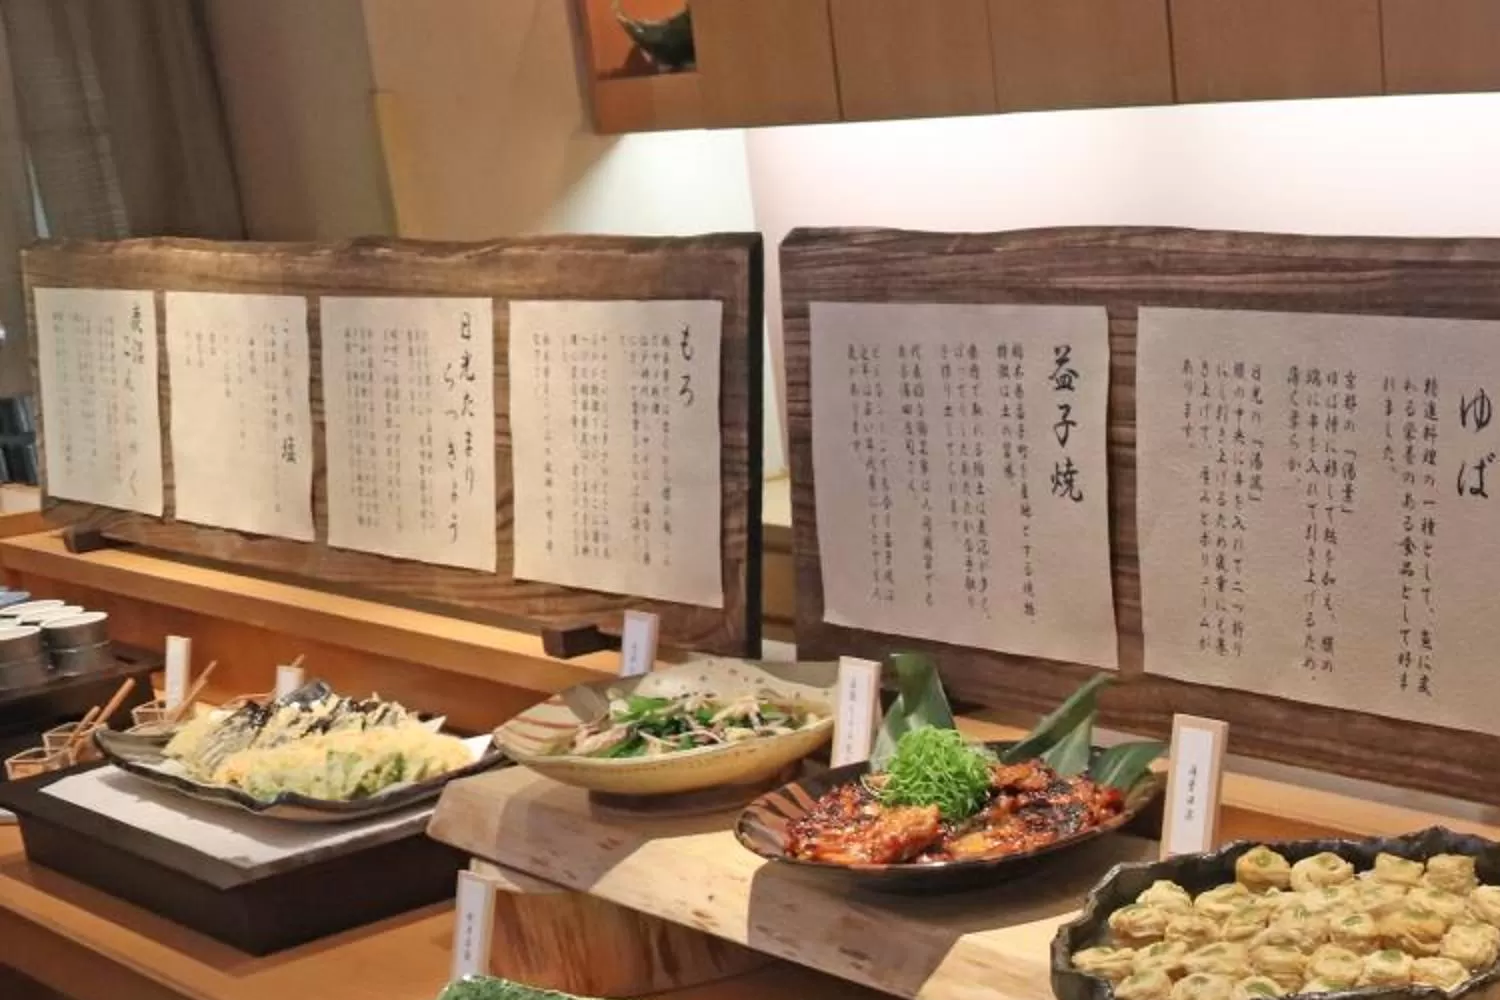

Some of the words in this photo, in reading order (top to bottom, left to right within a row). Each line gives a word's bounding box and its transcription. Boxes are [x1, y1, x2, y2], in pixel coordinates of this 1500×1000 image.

[679, 324, 694, 407] もろ
[1049, 345, 1083, 502] 益子焼
[1457, 389, 1496, 499] ゆば
